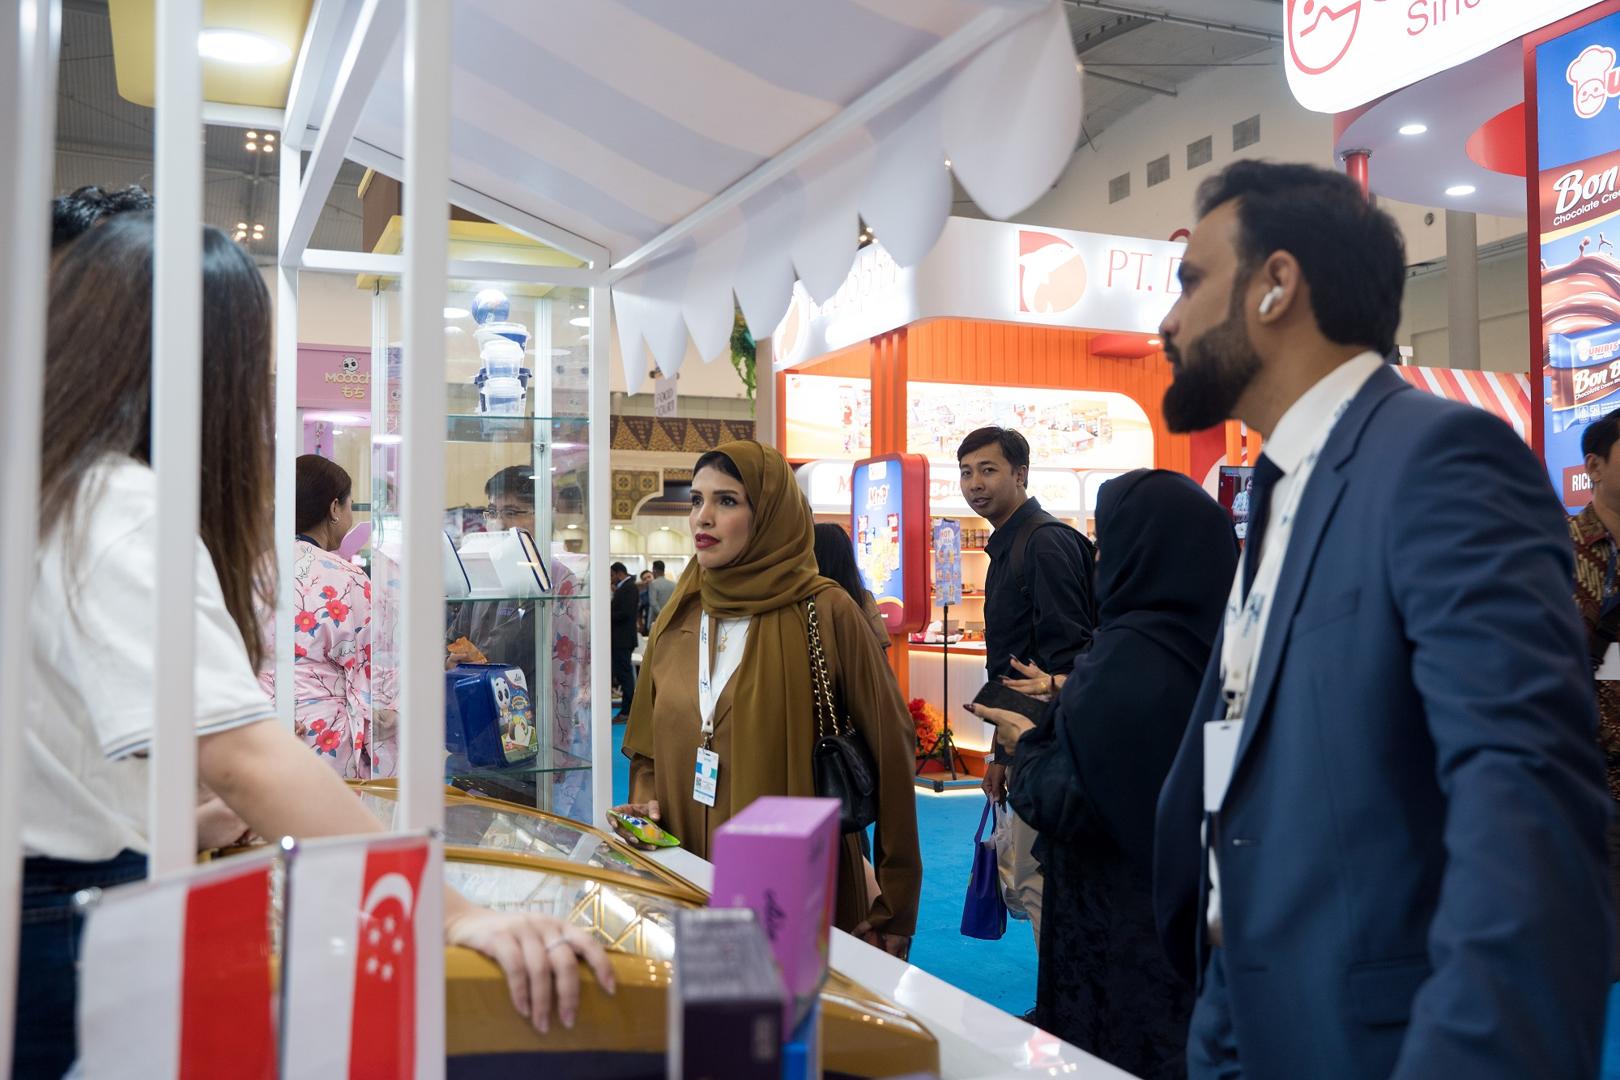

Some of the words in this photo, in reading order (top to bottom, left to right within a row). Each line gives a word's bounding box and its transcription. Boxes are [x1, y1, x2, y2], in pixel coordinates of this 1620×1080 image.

[1553, 165, 1619, 215] Bon
[1553, 200, 1600, 226] Chocolate
[1107, 249, 1153, 291] PT.
[341, 385, 365, 399] もち
[1574, 368, 1608, 394] Bon
